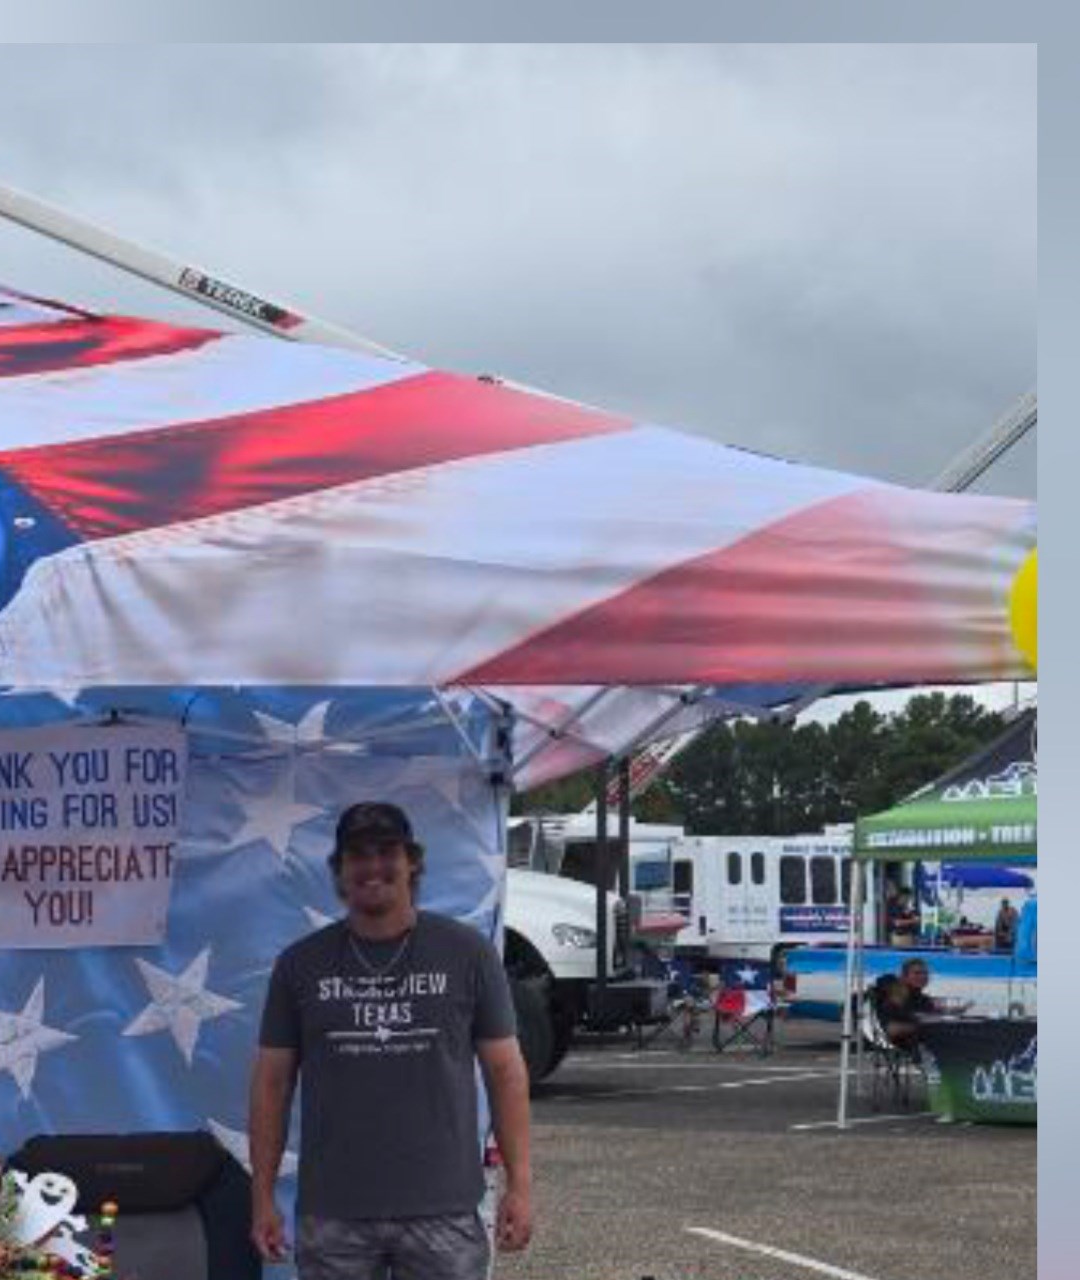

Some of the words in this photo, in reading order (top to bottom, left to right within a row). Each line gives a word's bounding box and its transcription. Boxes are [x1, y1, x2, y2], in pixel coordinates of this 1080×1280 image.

[50, 751, 109, 786] YOU
[126, 748, 178, 783] FOR
[63, 795, 118, 828] FOR
[133, 796, 177, 828] US!
[26, 890, 94, 927] YOU!
[318, 974, 447, 1000] STRONGVIEW
[352, 1002, 413, 1025] TEXAS
